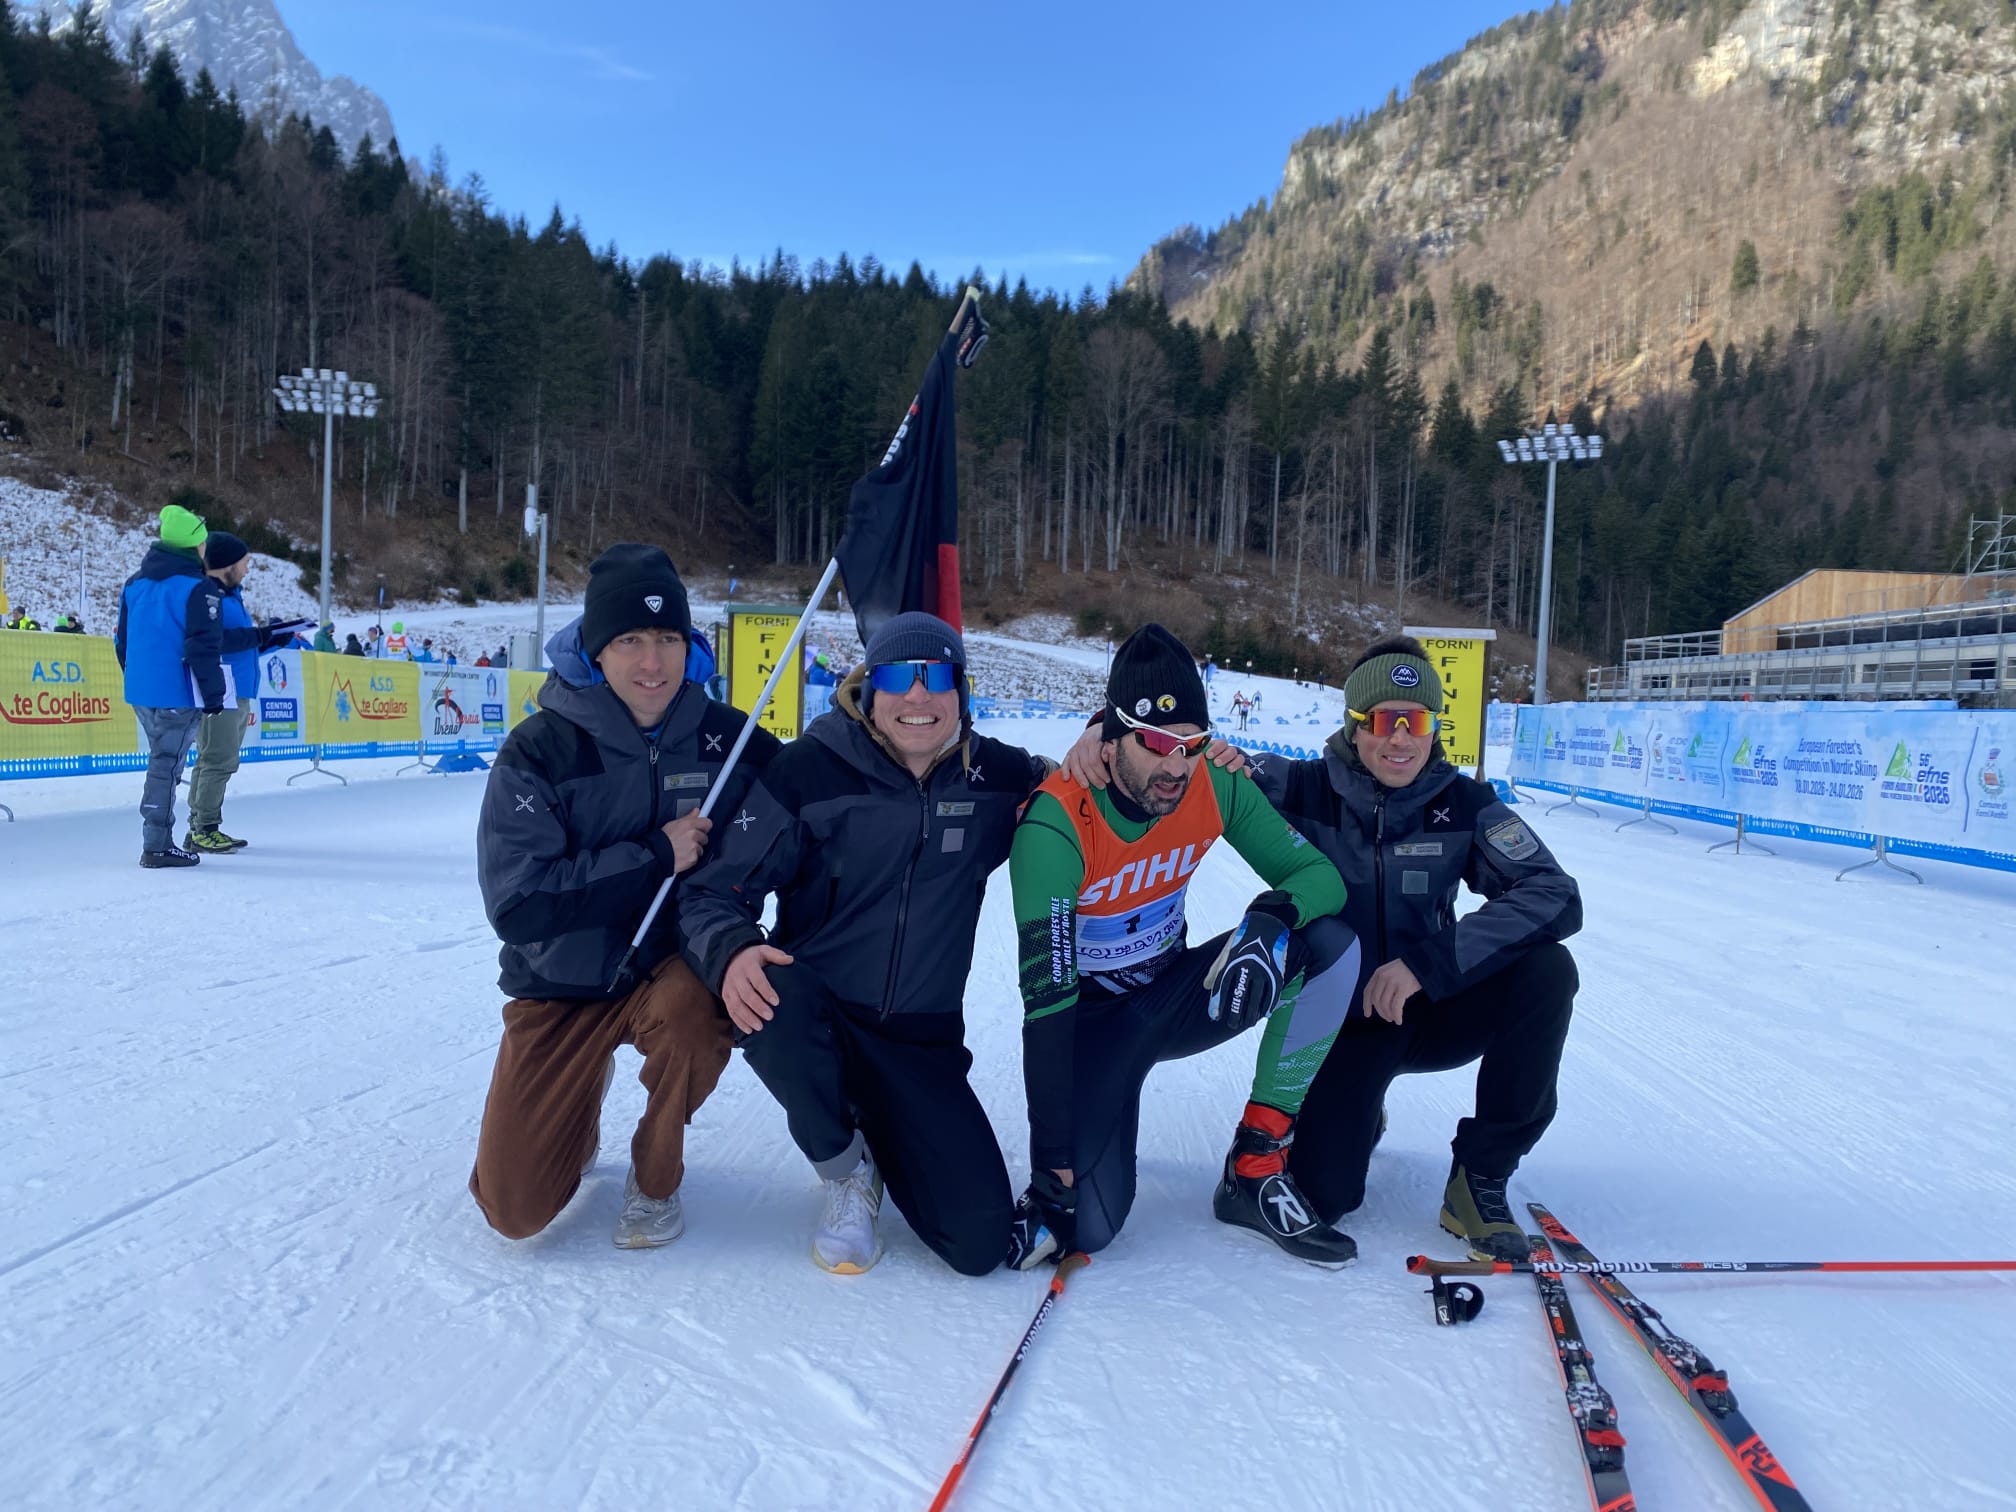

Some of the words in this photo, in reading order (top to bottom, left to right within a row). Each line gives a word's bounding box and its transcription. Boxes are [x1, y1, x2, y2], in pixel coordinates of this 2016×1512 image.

[745, 617, 790, 627] FORNI
[1426, 640, 1473, 650] FORNI
[31, 661, 85, 682] A.S.D.
[370, 676, 395, 691] A.S.D.
[37, 690, 110, 720] Coglians
[265, 701, 293, 710] CENTRO
[265, 710, 294, 719] FEDERALE
[373, 697, 408, 717] Coglians
[1754, 754, 1777, 770] efns
[1784, 756, 1822, 775] Competition
[1830, 759, 1854, 775] Nordic
[1854, 760, 1878, 781] Skiing
[1916, 766, 1950, 785] efns
[1923, 784, 1950, 804] 2026
[1077, 843, 1201, 907] STIHL
[1050, 896, 1061, 948] FORESTALE
[1061, 898, 1070, 937] D'AOSTA
[1123, 913, 1141, 935] 1
[1062, 938, 1072, 965] VALLE
[1052, 949, 1062, 983] CORPO
[1532, 1262, 1659, 1273] ROSSIGNOL
